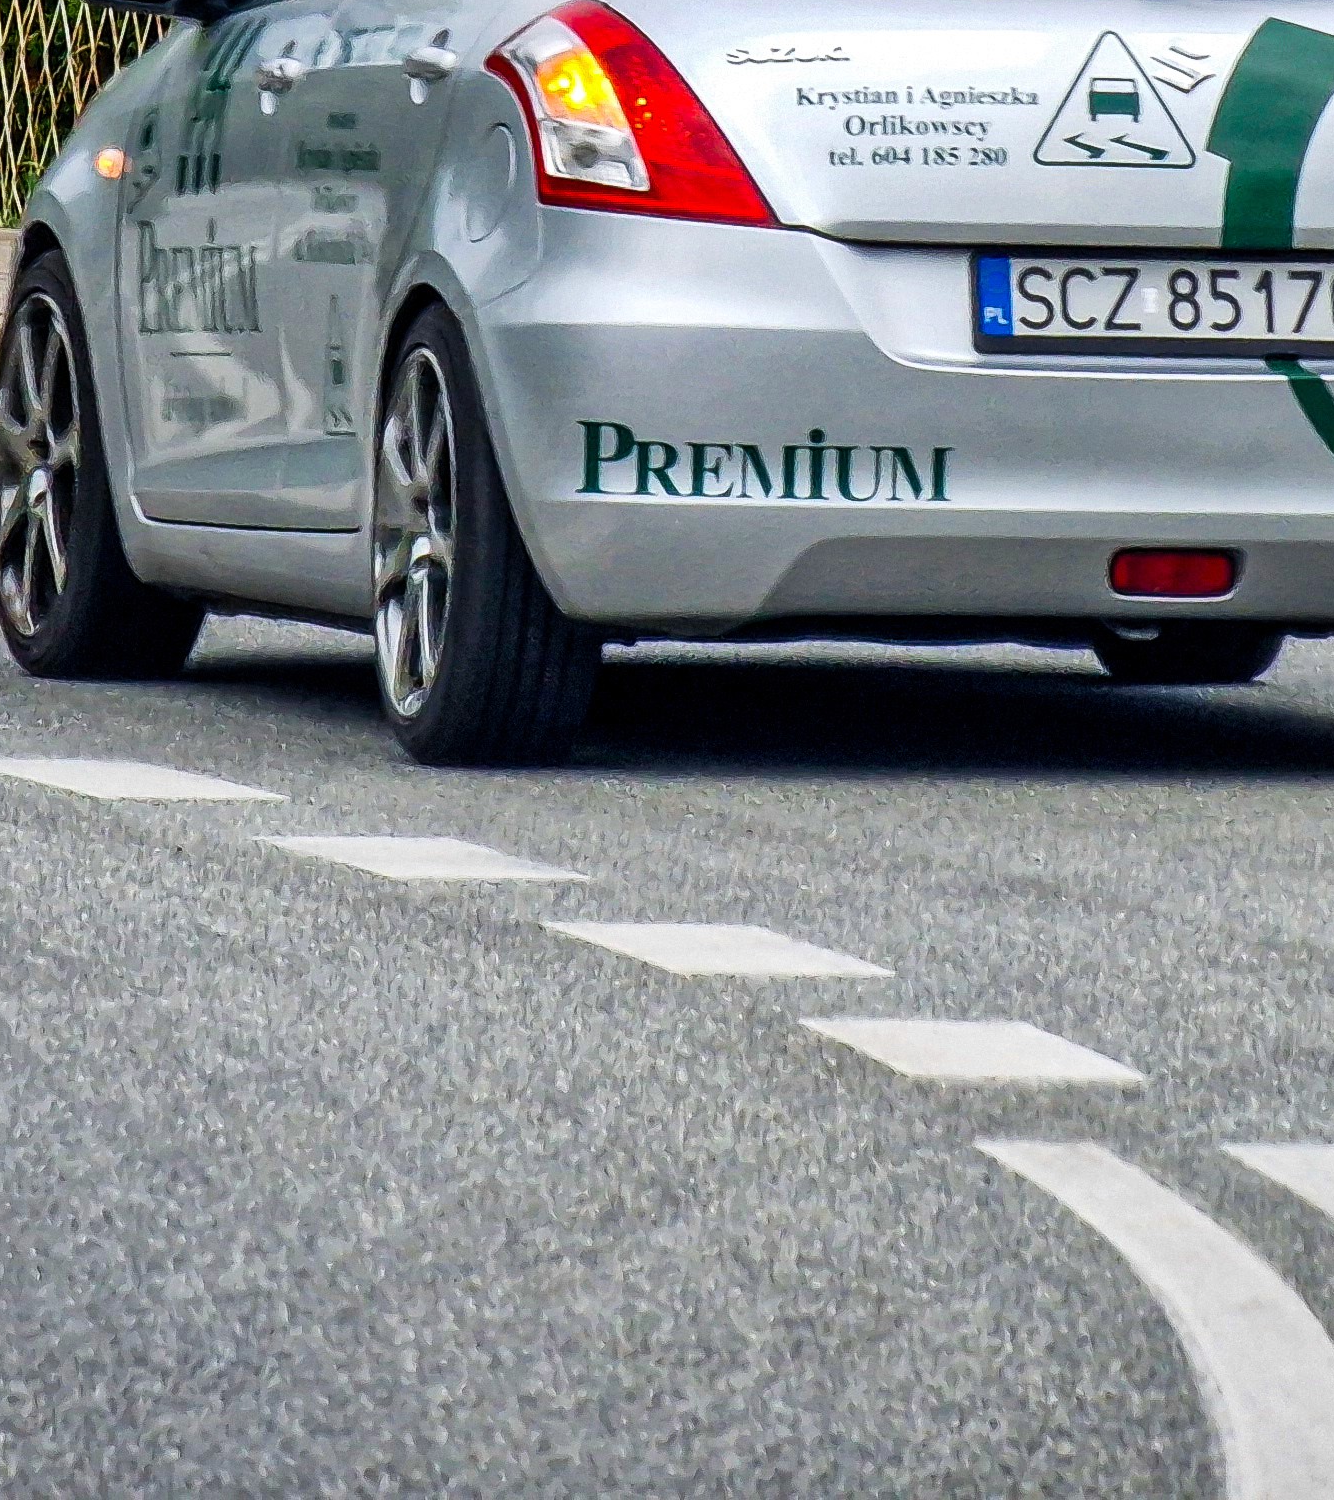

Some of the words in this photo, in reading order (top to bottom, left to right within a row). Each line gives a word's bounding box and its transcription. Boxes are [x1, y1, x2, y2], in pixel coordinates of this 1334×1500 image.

[796, 86, 899, 110] Krystian
[905, 85, 914, 104] i
[920, 86, 1040, 110] Agnieszka
[844, 114, 991, 141] Orlikowscy
[871, 146, 911, 165] 604
[1017, 266, 1142, 332] SCZ
[983, 306, 1009, 325] PL
